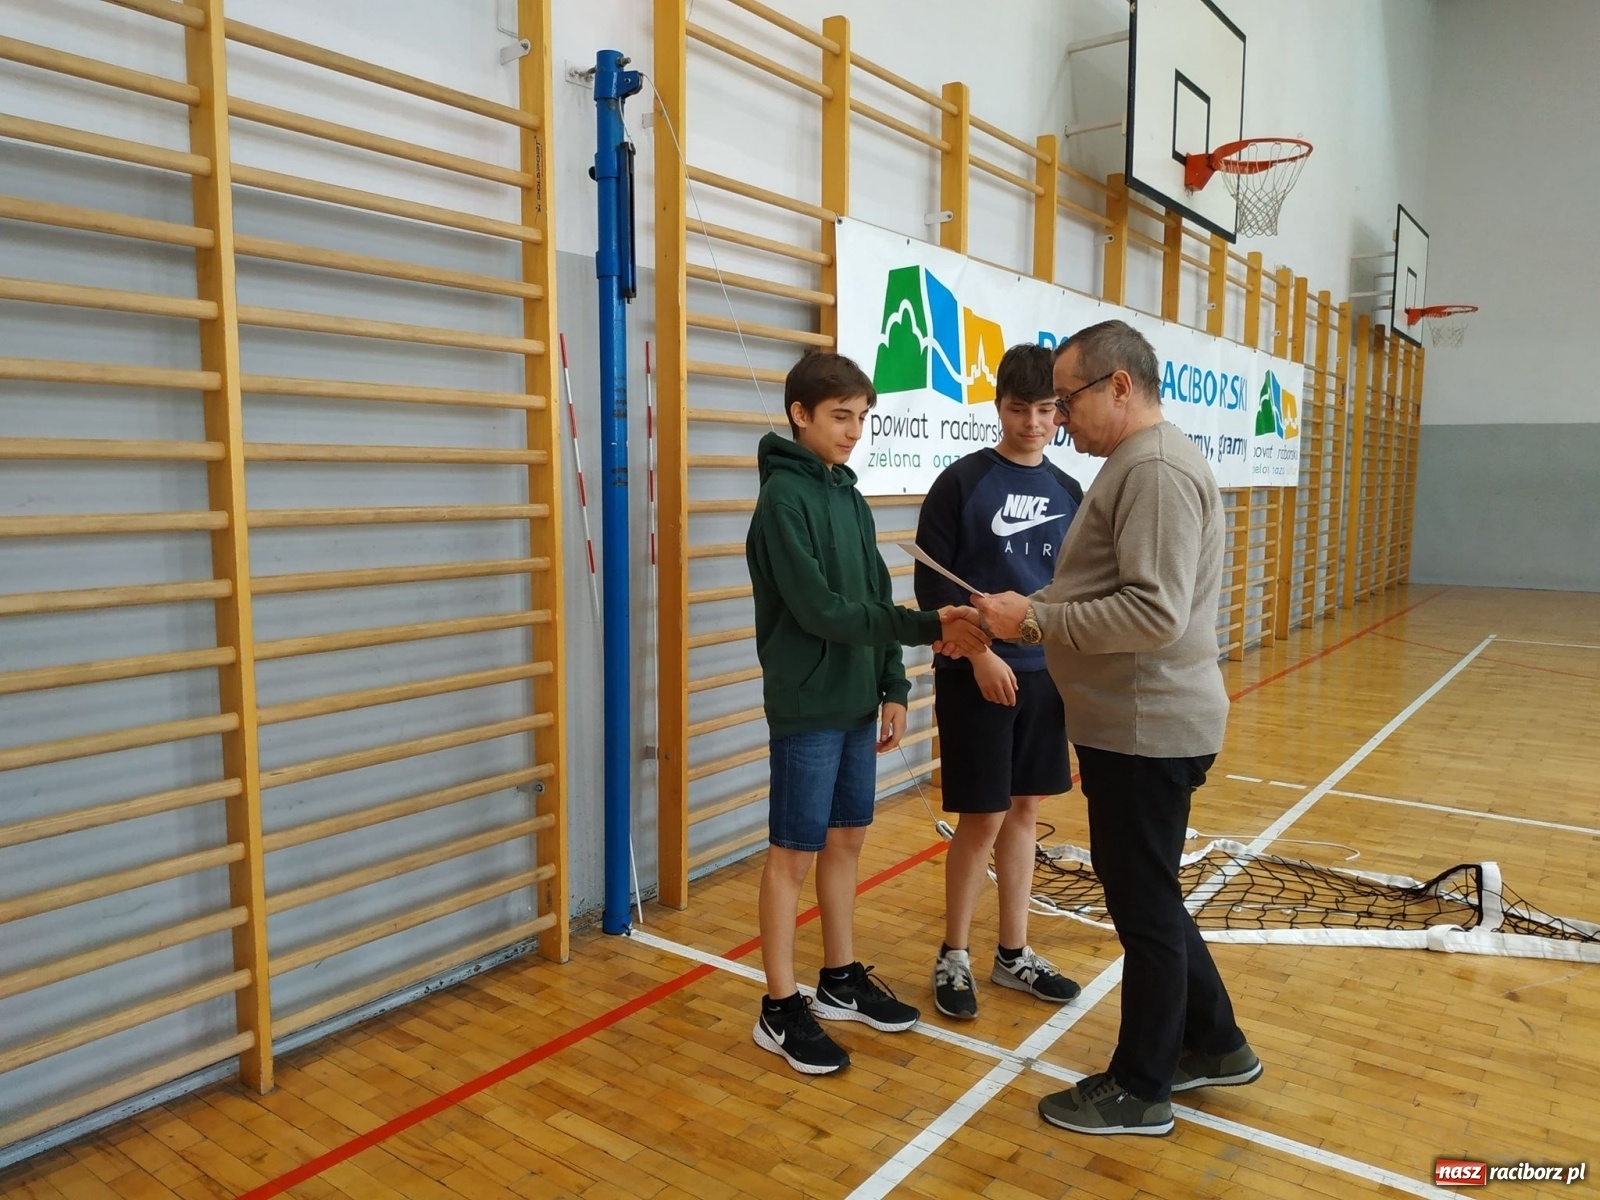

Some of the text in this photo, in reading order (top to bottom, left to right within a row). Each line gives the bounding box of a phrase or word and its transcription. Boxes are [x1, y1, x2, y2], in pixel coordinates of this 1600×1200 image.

[1161, 361, 1248, 411] ACIBORSKI
[871, 408, 1003, 445] powiat raciborsk
[868, 448, 921, 468] zielona
[1218, 434, 1248, 463] gramy
[1003, 493, 1050, 520] NIKE
[1004, 540, 1052, 556] AIR
